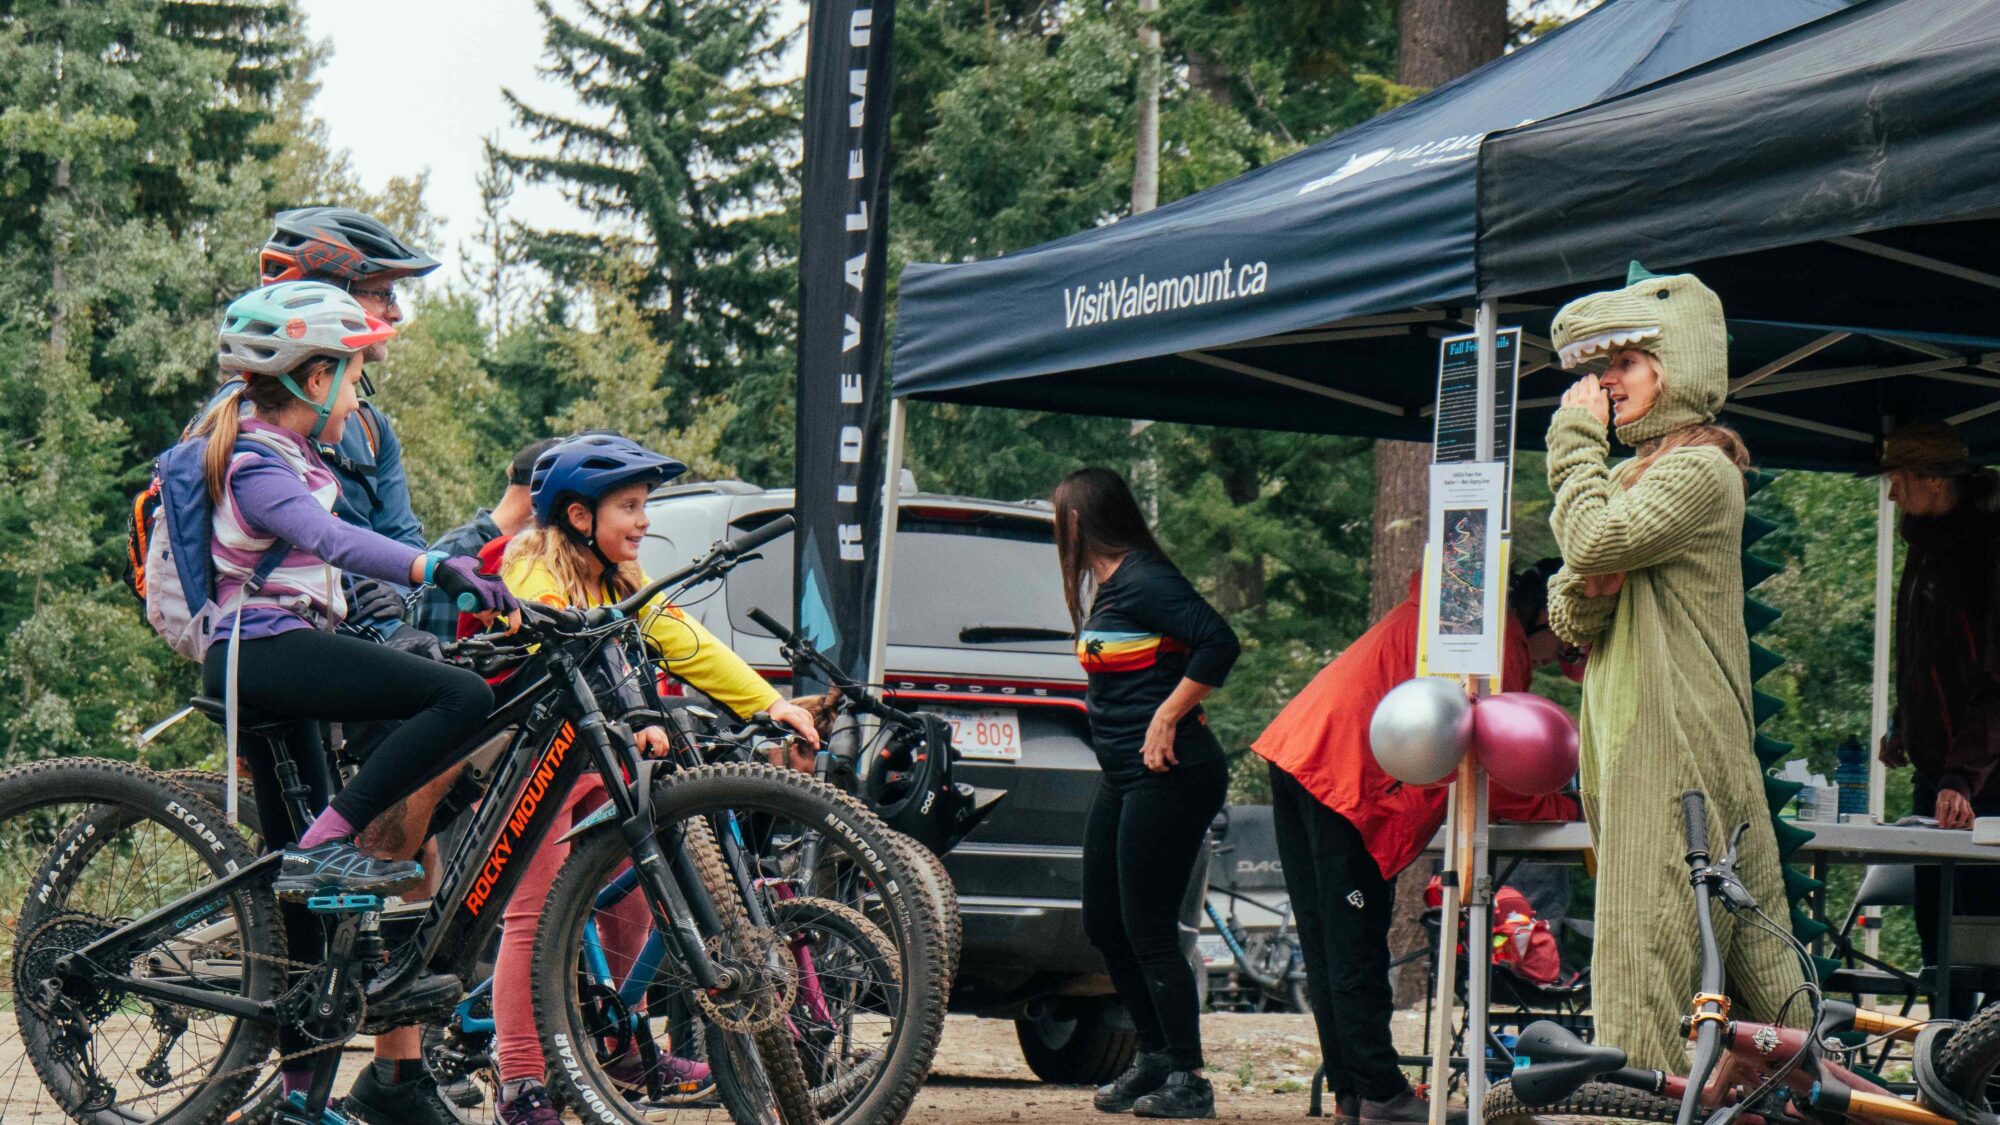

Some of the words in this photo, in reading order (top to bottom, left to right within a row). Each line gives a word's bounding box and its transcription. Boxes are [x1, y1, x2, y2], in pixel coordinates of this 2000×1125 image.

[1064, 258, 1268, 329] VisitValemount.ca
[899, 681, 1048, 696] DODGE
[950, 720, 1013, 747] Z-809
[164, 800, 226, 854] ESCAPE
[824, 812, 888, 873] NEWTON
[38, 824, 97, 904] MAXXIS
[466, 838, 512, 916] ROCKY
